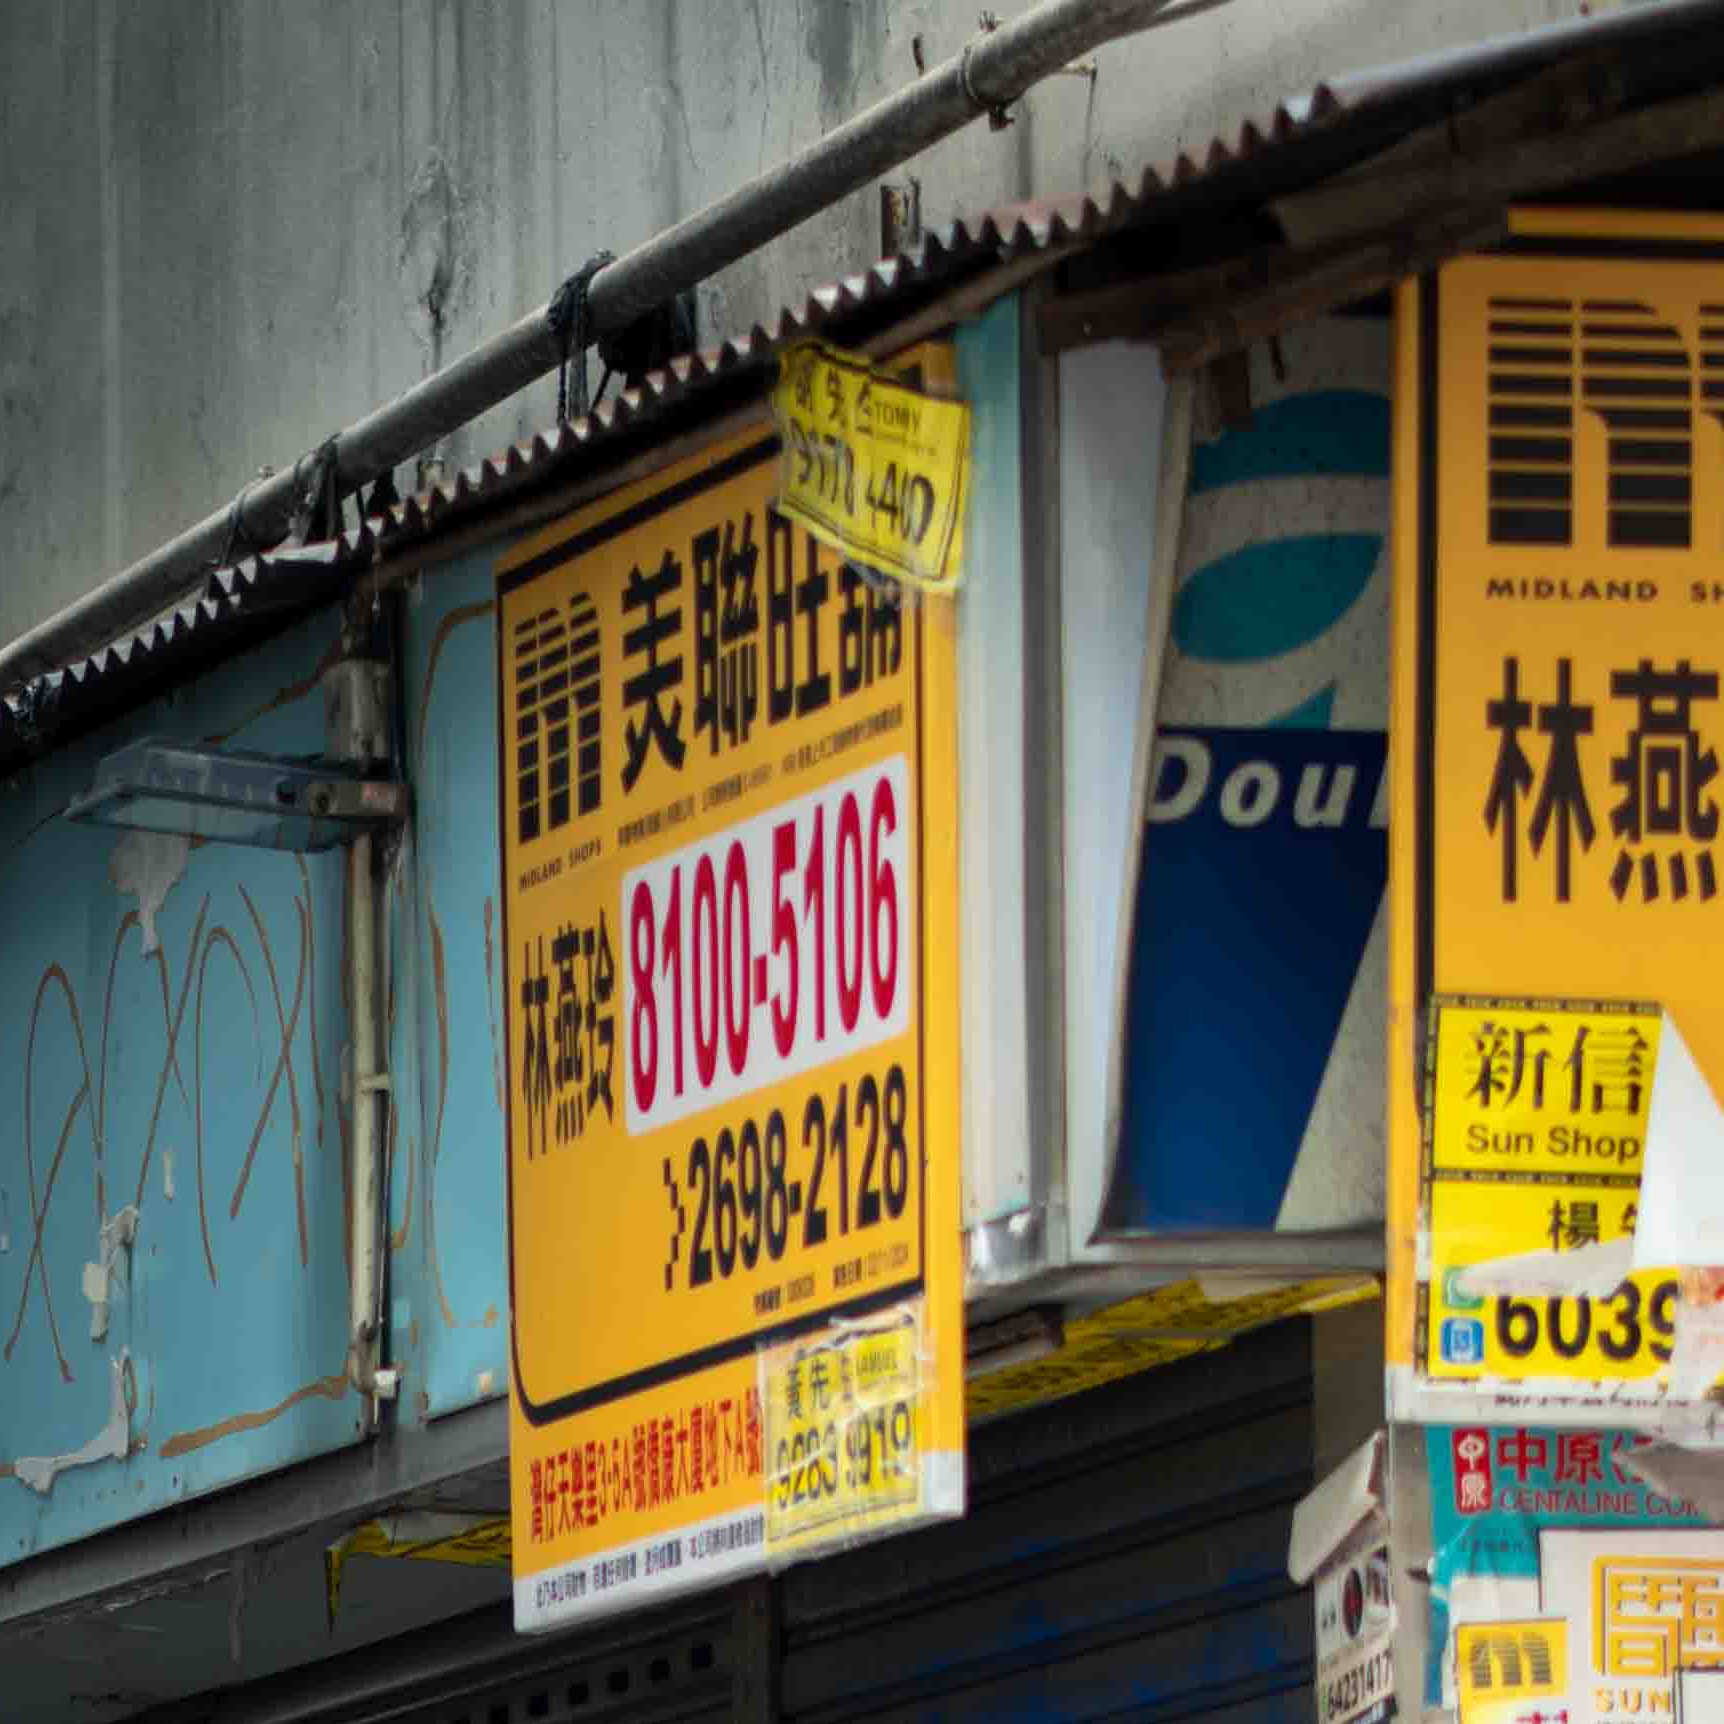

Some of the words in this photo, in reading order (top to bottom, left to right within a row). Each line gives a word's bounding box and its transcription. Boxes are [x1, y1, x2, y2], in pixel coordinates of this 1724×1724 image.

[1485, 579, 1659, 604] MIDLAND
[1147, 735, 1389, 829] Dou
[629, 775, 899, 1114] 8100-5106
[520, 903, 617, 1162] 林燕玲
[1466, 1020, 1648, 1117] 新信
[687, 1062, 910, 1291] 2698-2128
[1467, 1124, 1535, 1158] Sun
[1548, 1125, 1641, 1163] Shop
[1498, 1488, 1637, 1513] CENTALINE
[1593, 1687, 1672, 1713] SUN
